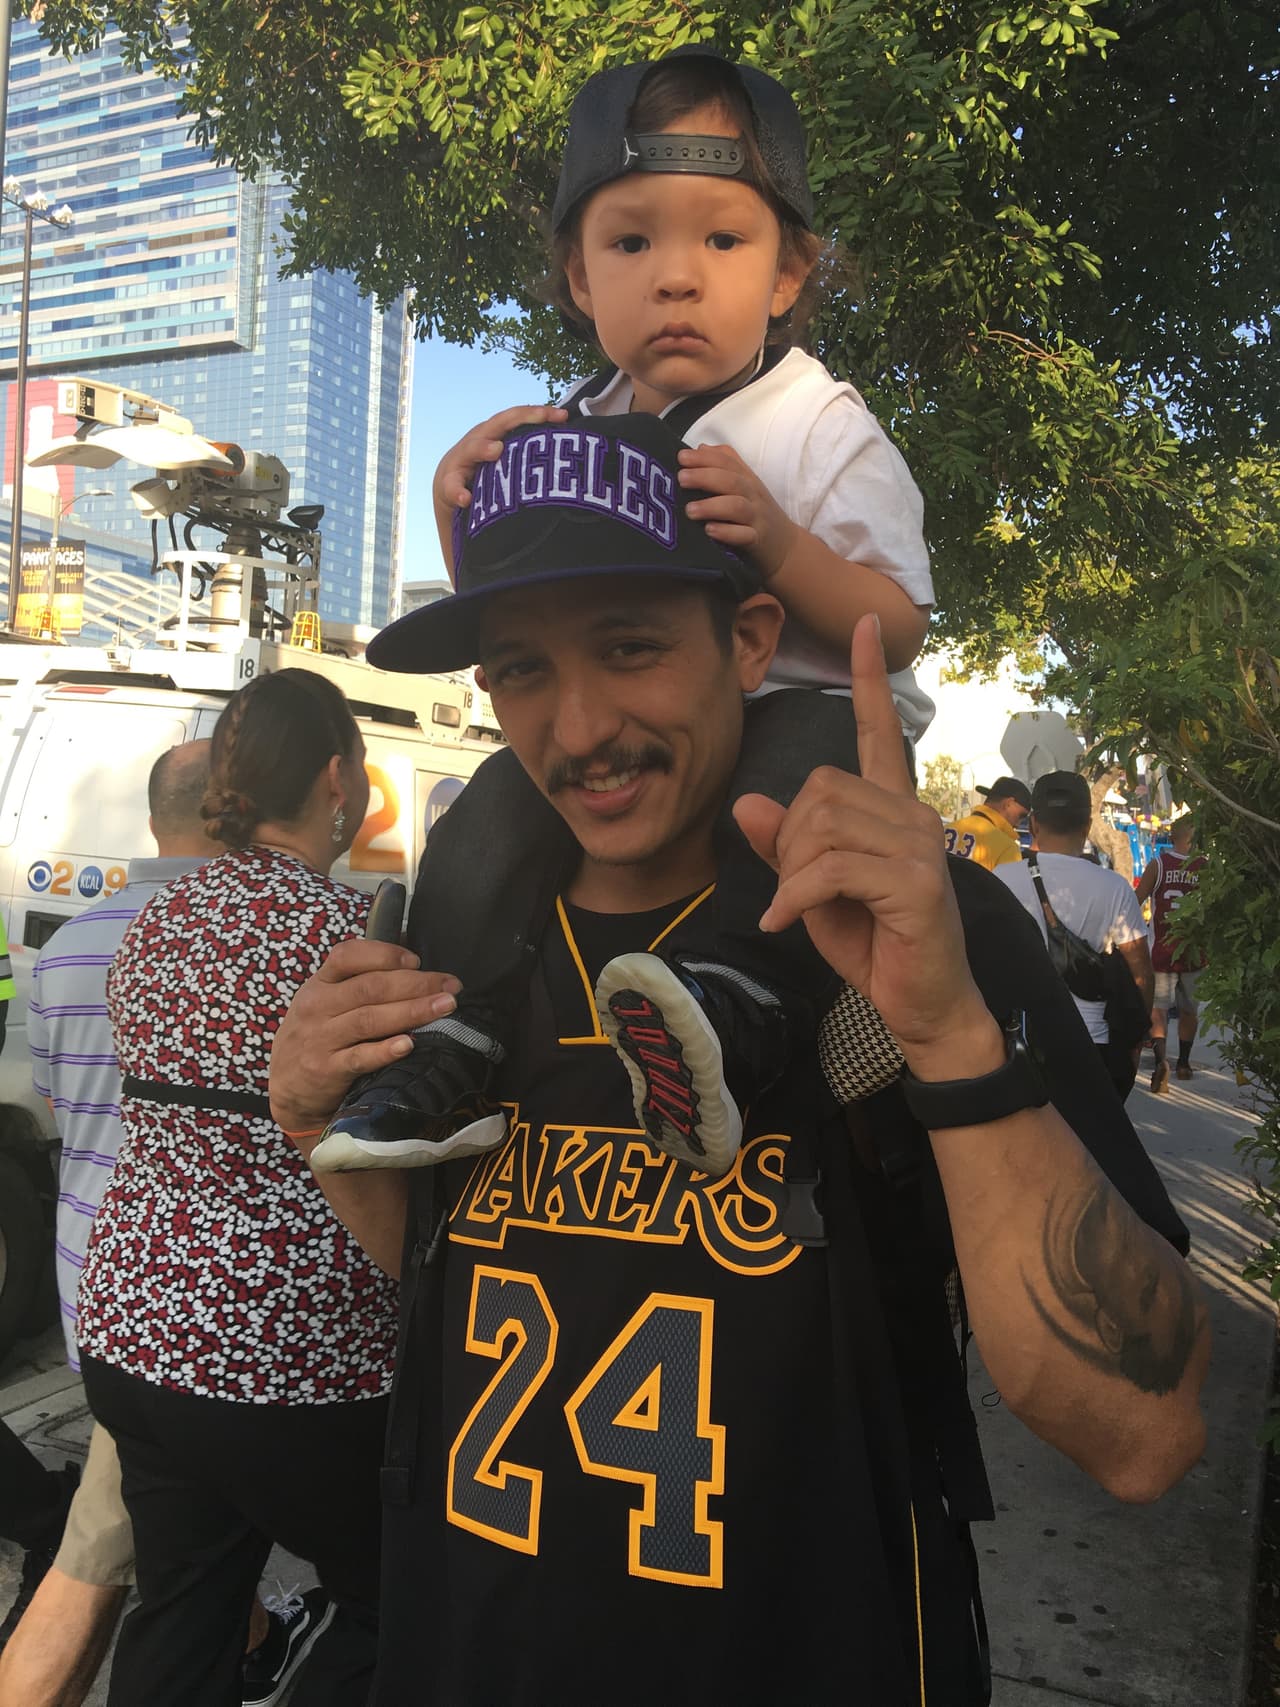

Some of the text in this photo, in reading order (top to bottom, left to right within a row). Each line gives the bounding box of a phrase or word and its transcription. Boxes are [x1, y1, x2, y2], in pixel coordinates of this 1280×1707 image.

[468, 430, 678, 550] ANGELES
[240, 658, 255, 679] 18
[463, 691, 473, 709] 18
[50, 860, 127, 897] 2 KCAL 9
[447, 1264, 726, 1590] 24
